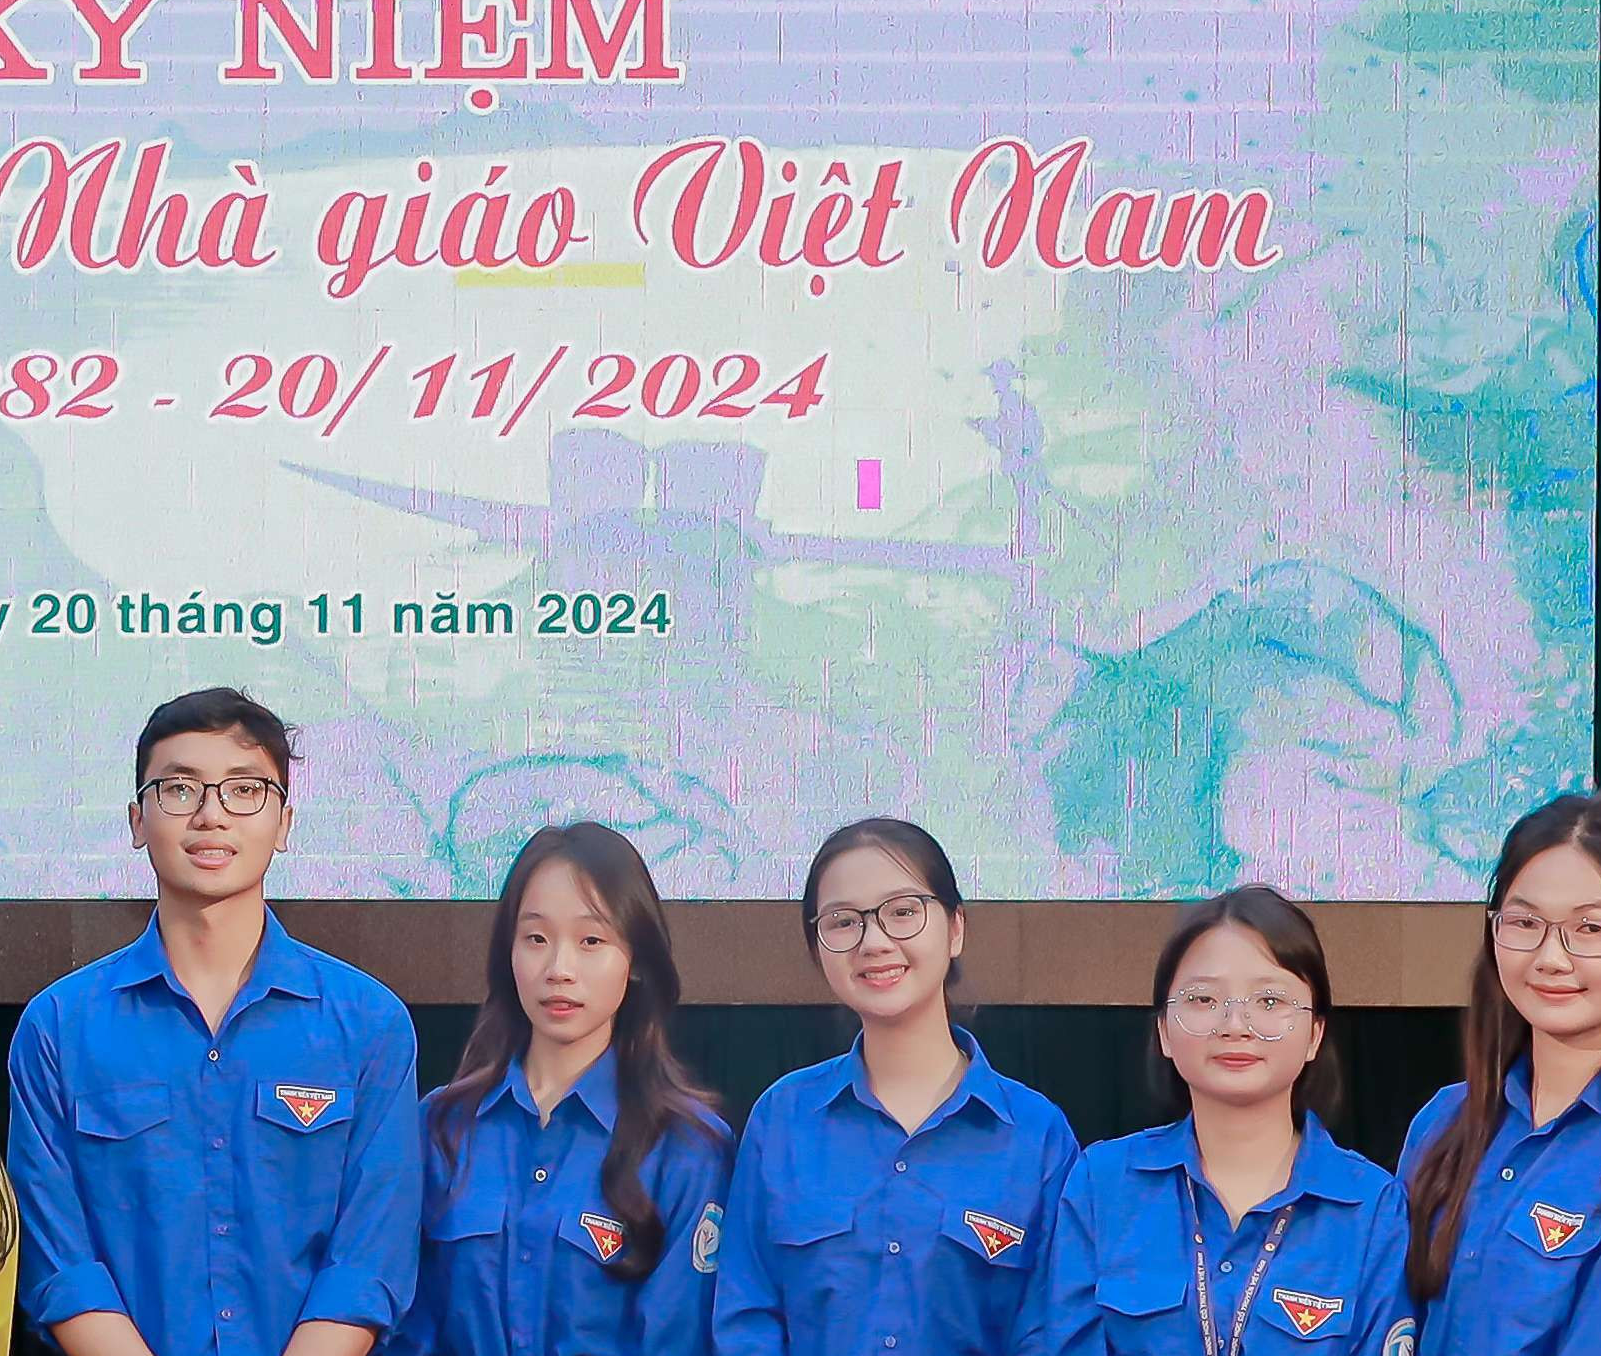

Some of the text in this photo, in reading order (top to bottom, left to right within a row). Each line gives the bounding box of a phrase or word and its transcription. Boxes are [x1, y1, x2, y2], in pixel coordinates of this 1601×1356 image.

[319, 162, 585, 300] giáo
[633, 140, 905, 296] Việt
[950, 140, 1277, 270] Nam
[32, 593, 96, 635] 20
[118, 590, 282, 646] tháng
[308, 593, 363, 634] 11
[393, 592, 514, 635] năm
[537, 592, 671, 635] 2024
